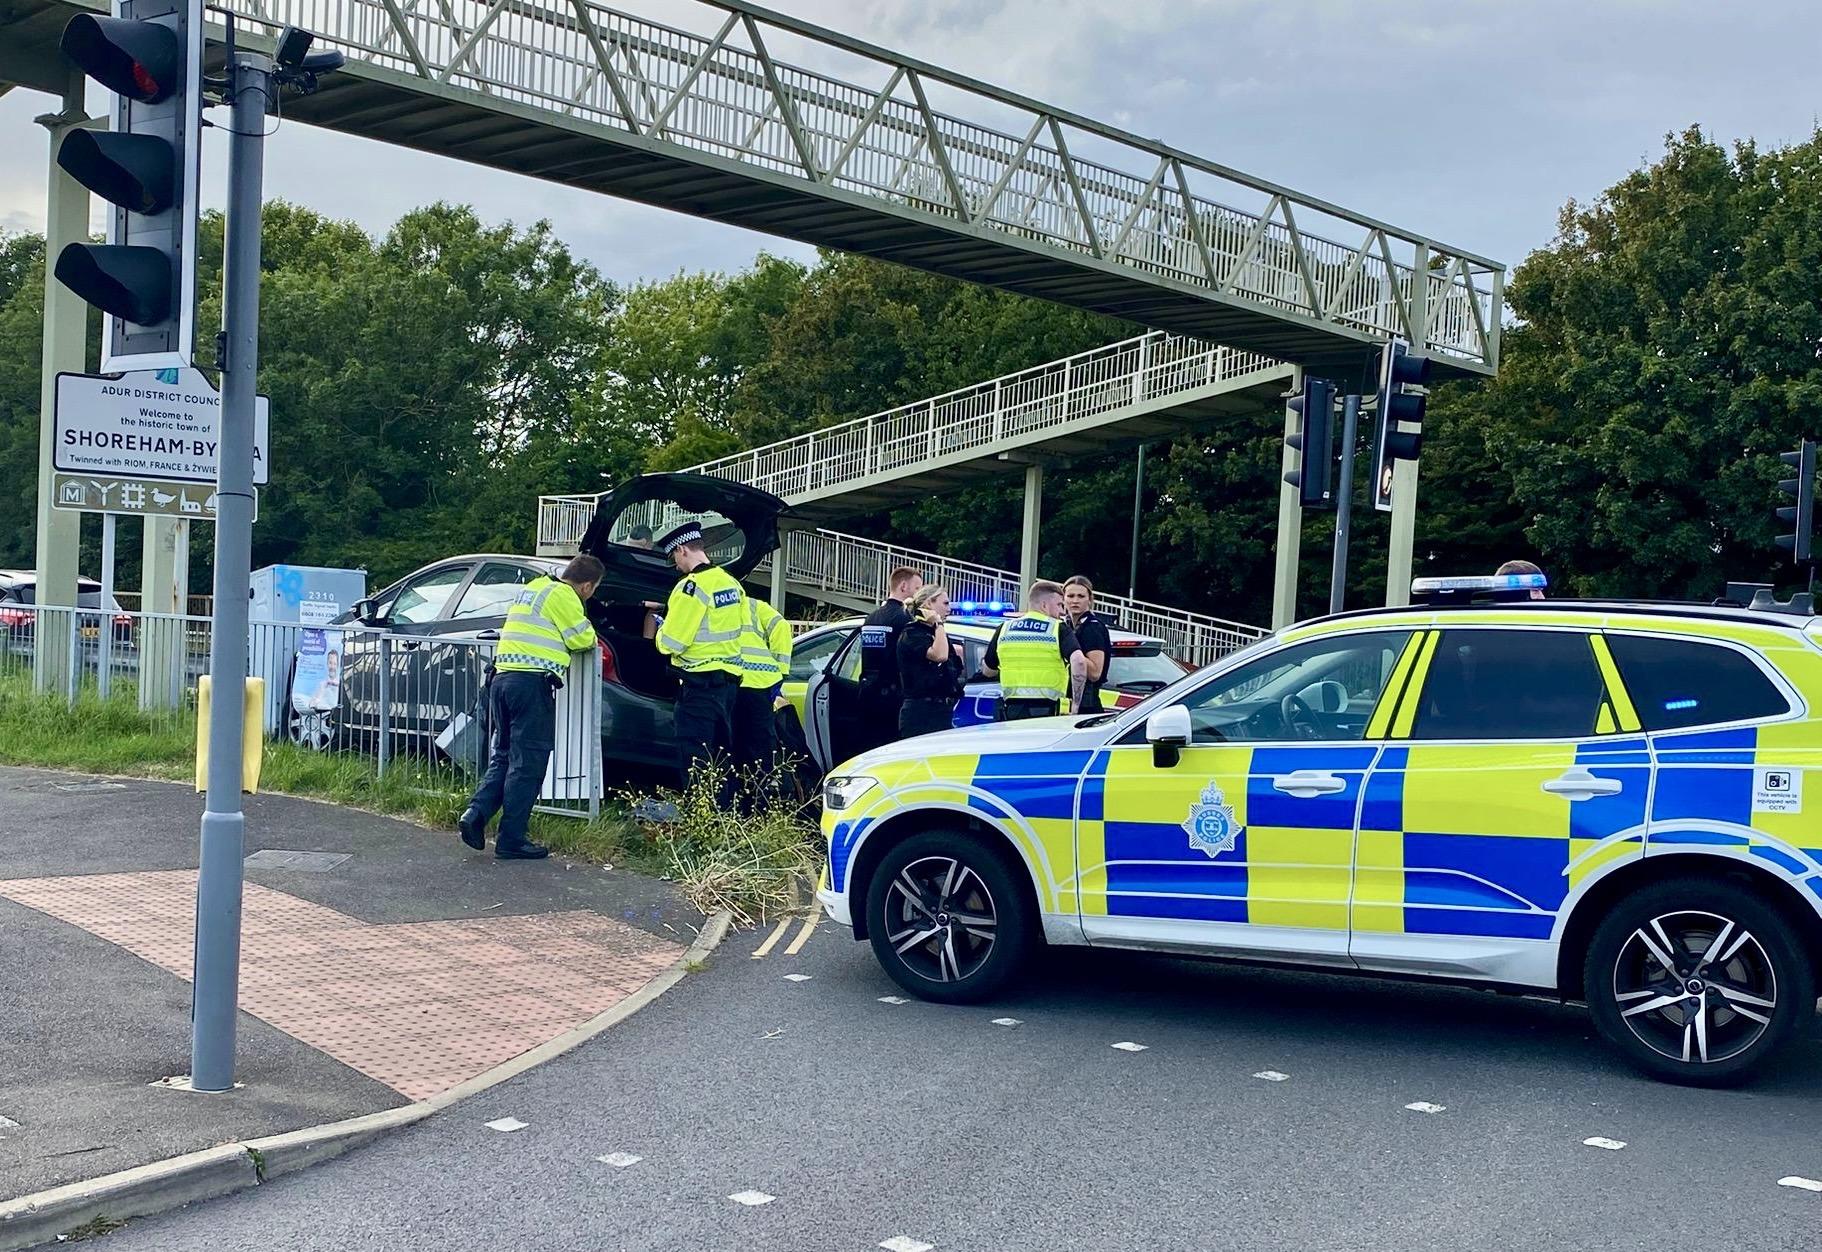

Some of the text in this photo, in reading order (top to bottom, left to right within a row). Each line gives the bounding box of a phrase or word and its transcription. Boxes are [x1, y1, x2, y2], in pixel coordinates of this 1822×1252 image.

[101, 386, 220, 406] ADUR DISTRICT COUNC
[139, 408, 194, 421] Welcome to
[120, 417, 211, 433] the historic town of
[69, 454, 217, 474] Twinned with RIOM, FRANCE & ŻYWIE
[1011, 619, 1048, 631] POLICE
